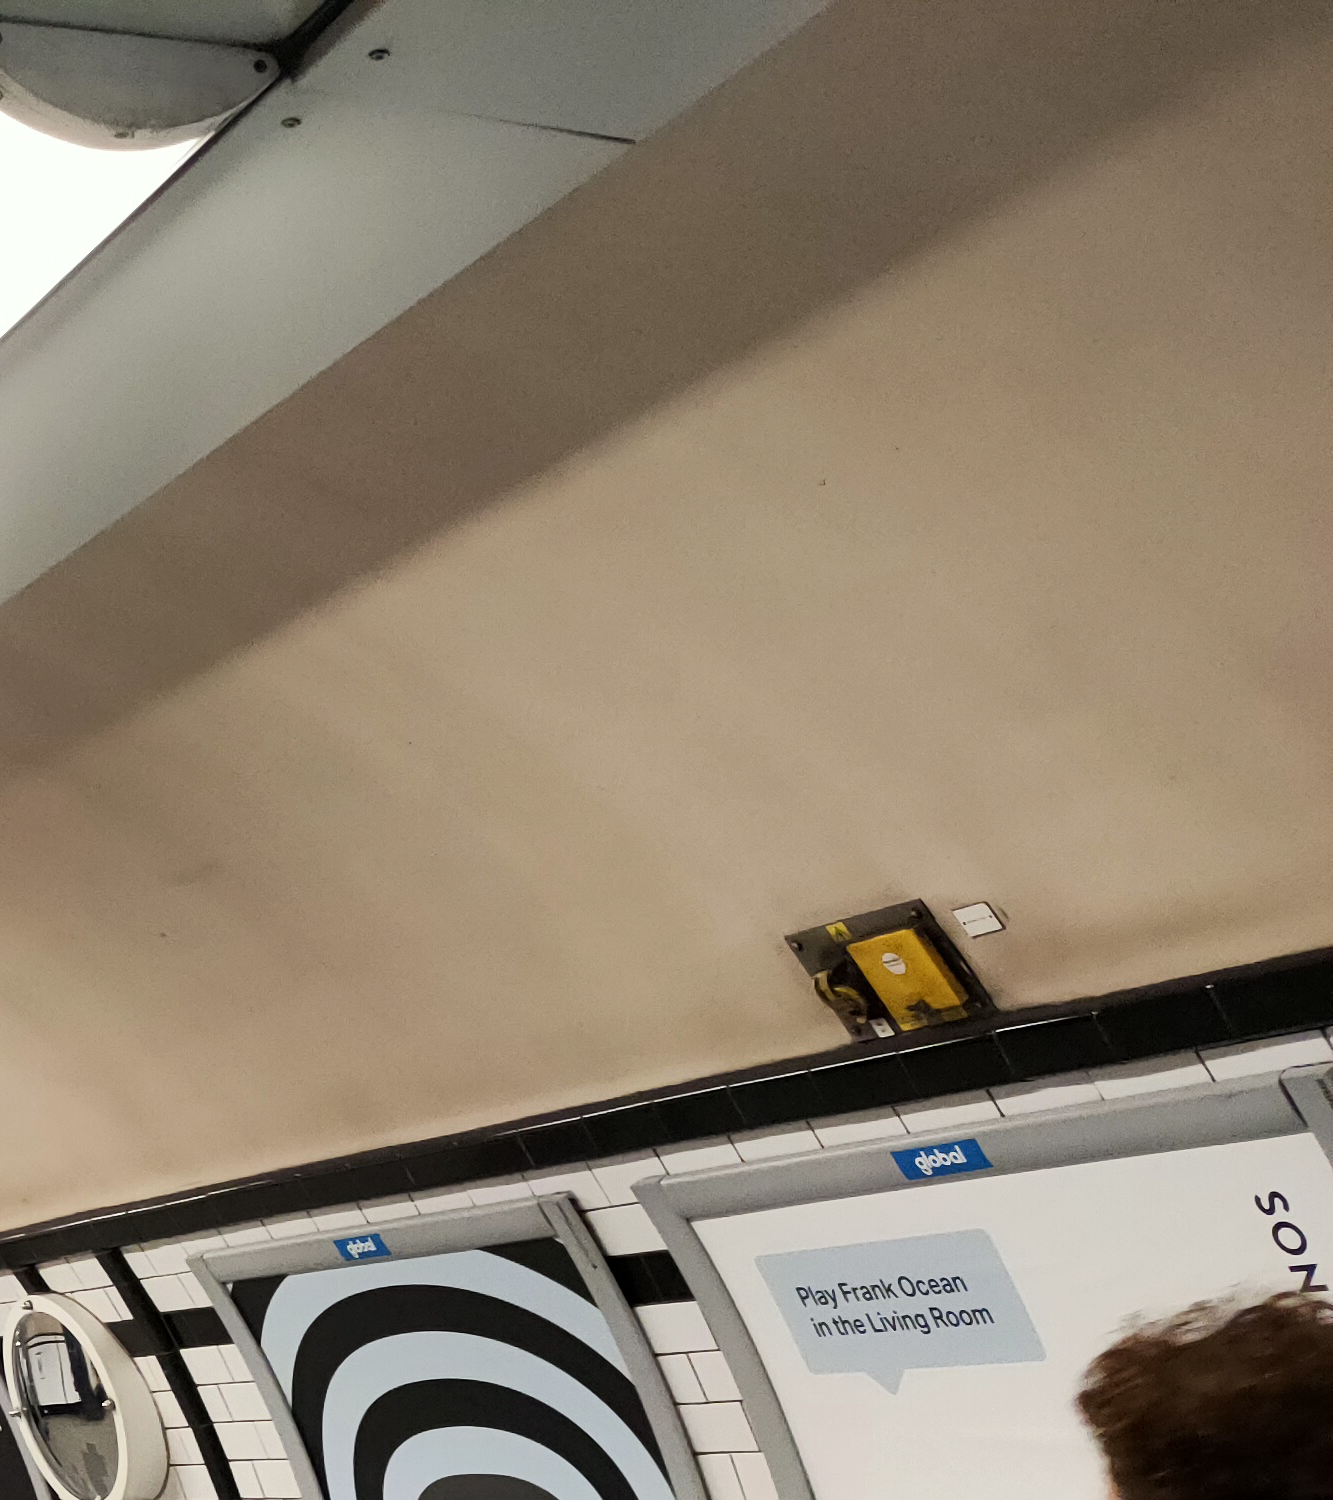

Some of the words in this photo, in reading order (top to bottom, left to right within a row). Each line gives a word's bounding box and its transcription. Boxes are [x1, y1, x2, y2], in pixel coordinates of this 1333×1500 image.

[915, 1145, 967, 1176] global
[796, 1285, 838, 1310] Play
[837, 1279, 899, 1304] Frank
[897, 1275, 969, 1298] Ocean
[810, 1317, 833, 1338] in
[832, 1315, 867, 1336] the
[866, 1310, 932, 1335] Living
[929, 1306, 995, 1329] Room
